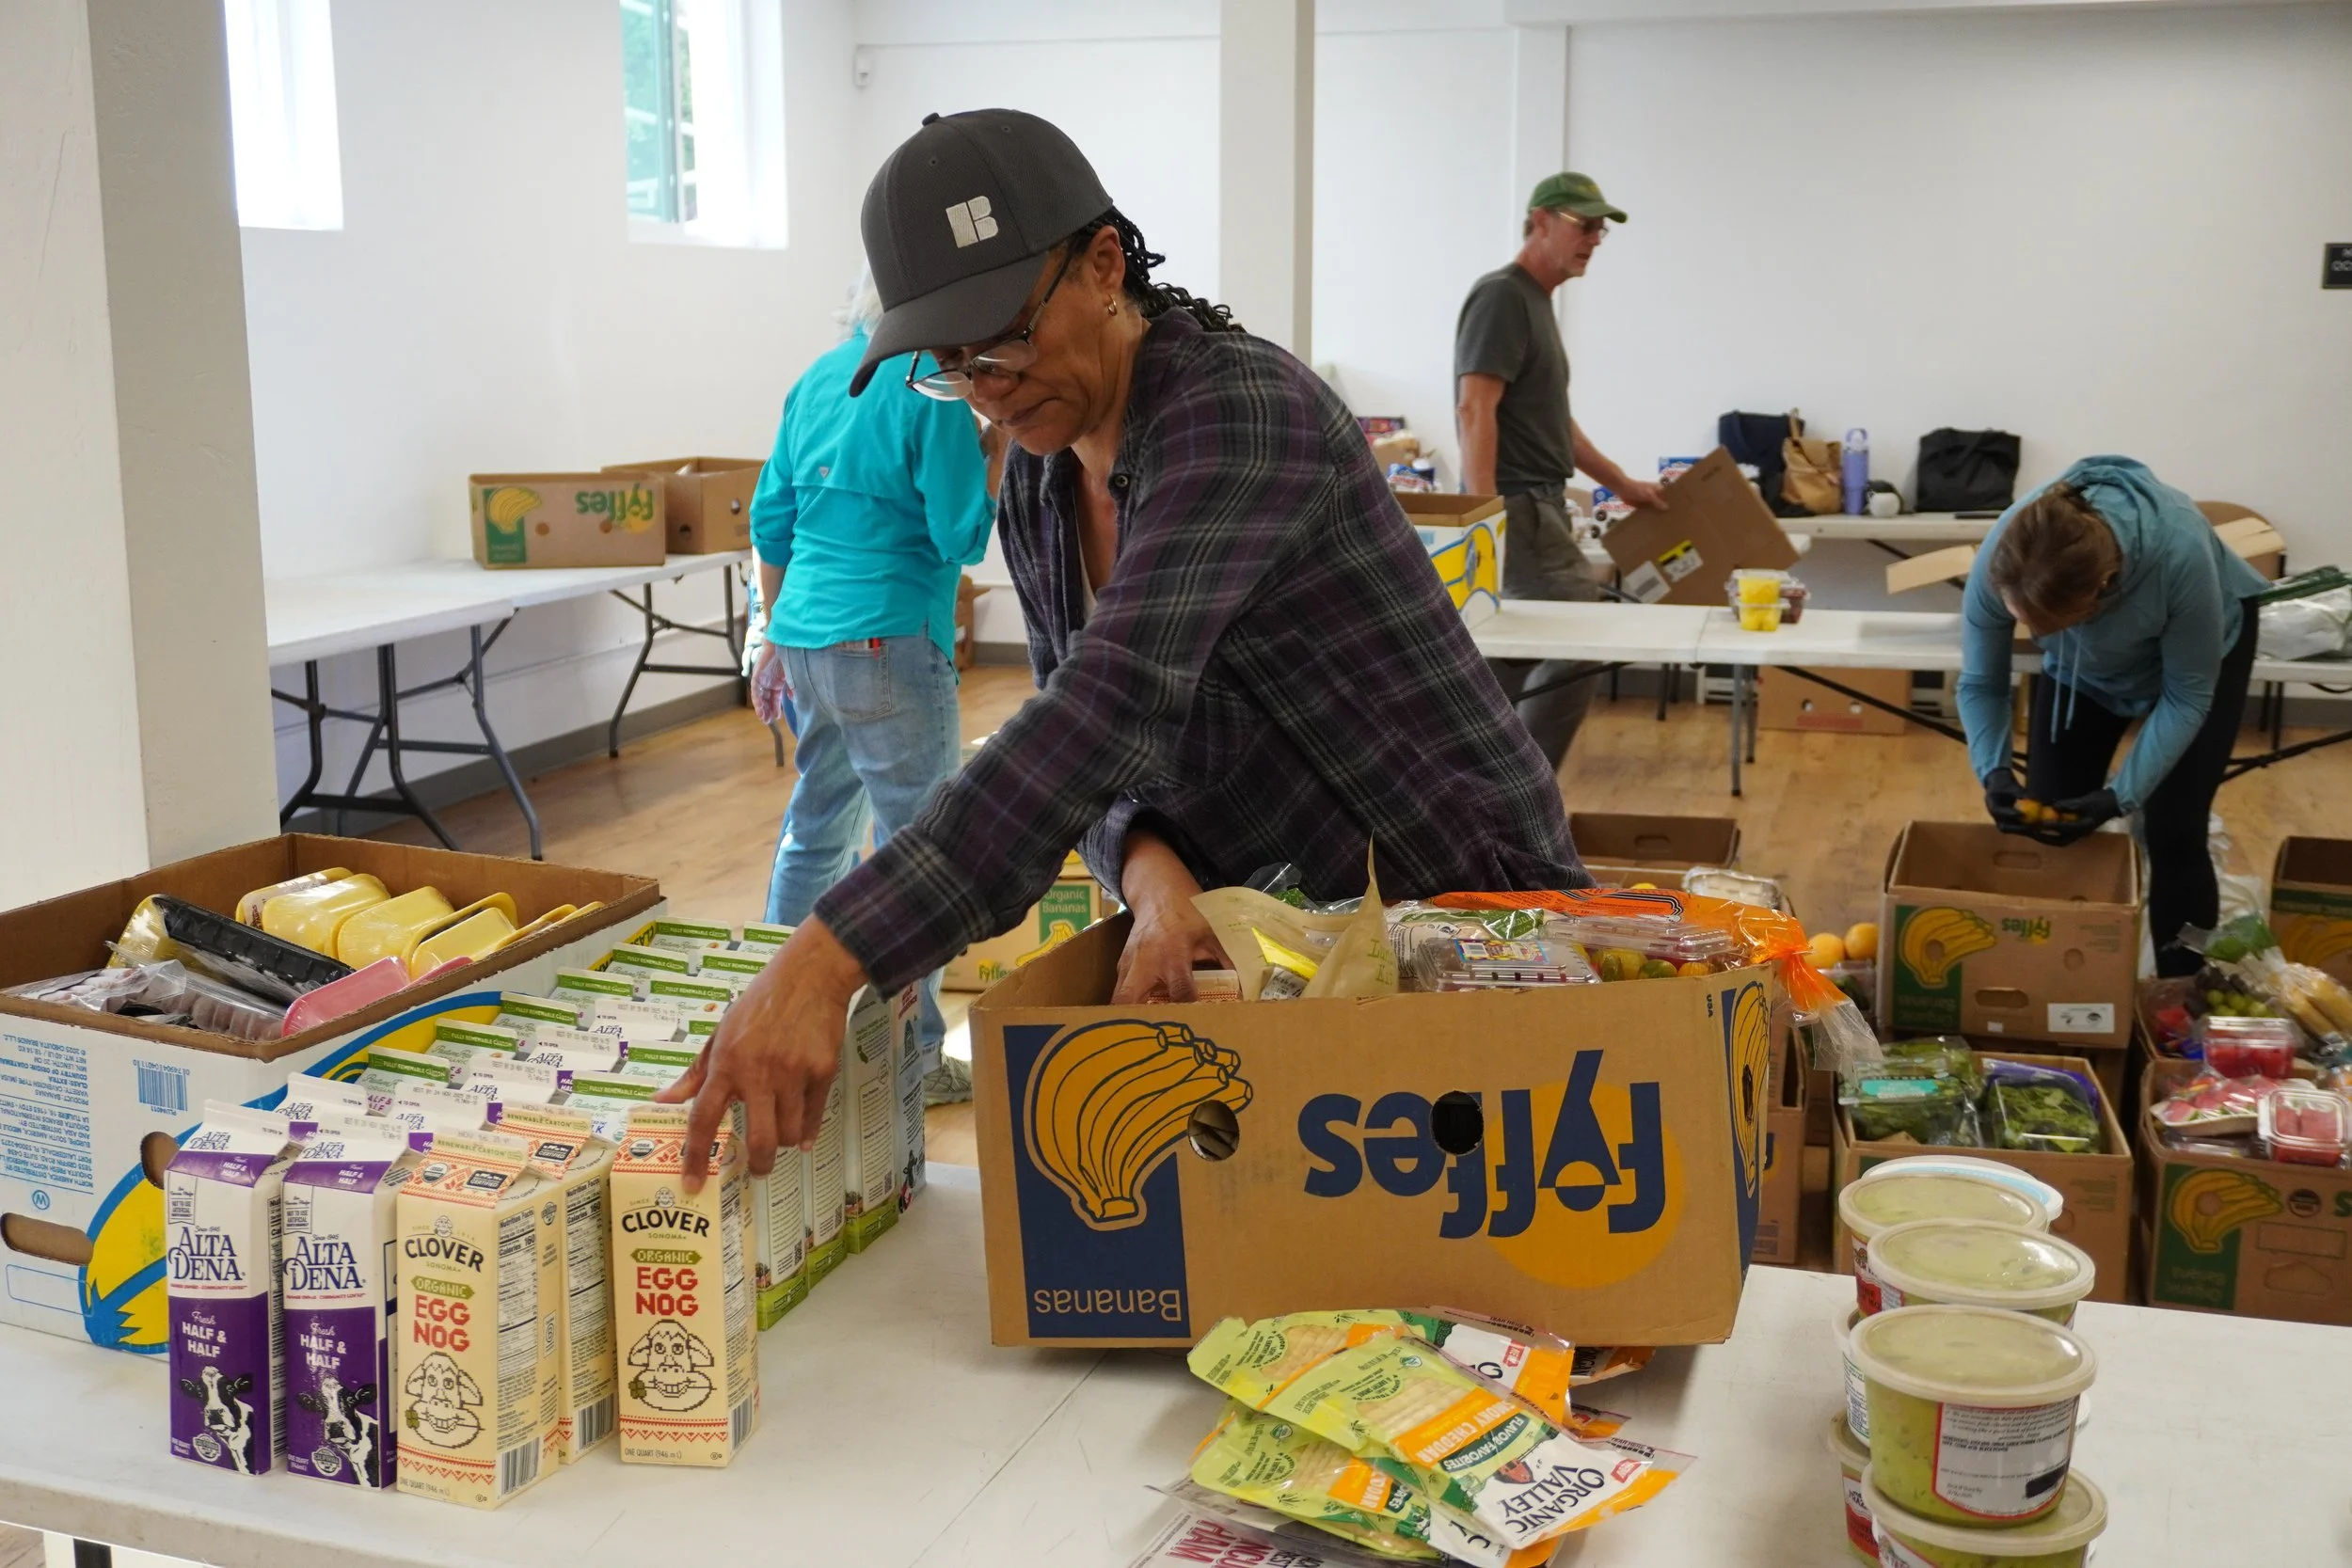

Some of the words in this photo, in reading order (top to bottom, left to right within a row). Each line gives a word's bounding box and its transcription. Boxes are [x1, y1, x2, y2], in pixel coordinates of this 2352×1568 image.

[286, 1102, 313, 1113] ALTA
[507, 1113, 543, 1124] RENEWABLE
[543, 1117, 571, 1128] CARTON
[190, 1138, 229, 1150] DENA
[201, 1132, 231, 1143] ALTA
[315, 1142, 345, 1152] ALTA
[437, 1139, 475, 1150] RENEWABLE
[475, 1145, 506, 1157] CARTON
[303, 1147, 344, 1159] DENA
[338, 1176, 358, 1185] HALF
[339, 1169, 357, 1178] HALF
[470, 1178, 499, 1188] CERTIFIED
[567, 1211, 588, 1224] Calories
[591, 1200, 601, 1212] 160
[622, 1210, 710, 1238] CLOVER
[179, 1227, 237, 1257] ALTA
[294, 1237, 357, 1266] ALTA
[499, 1243, 522, 1257] Calories
[524, 1235, 535, 1245] 160
[168, 1247, 243, 1281] DENA
[405, 1237, 484, 1273] CLOVER
[637, 1250, 693, 1264] ORGANIC
[283, 1258, 363, 1291] DENA
[426, 1261, 459, 1273] SONOMA
[416, 1277, 468, 1298] ORGANIC
[637, 1266, 698, 1291] EGG
[415, 1294, 470, 1326] EGG
[636, 1291, 699, 1317] NOG
[1035, 1288, 1181, 1322] Bananas
[191, 1310, 216, 1325] Fresh
[182, 1322, 214, 1339] HALF
[216, 1331, 227, 1344] &
[310, 1323, 335, 1337] Fresh
[414, 1320, 470, 1353] NOG
[188, 1339, 220, 1358] HALF
[300, 1334, 333, 1353] HALF
[337, 1340, 347, 1354] &
[306, 1353, 341, 1370] HALF
[1491, 1416, 1524, 1446] FLAVOR
[636, 1449, 653, 1458] QUART
[1415, 1423, 1477, 1464] CHEDDAR
[1443, 1438, 1496, 1471] FAVORITES
[400, 1477, 408, 1485] ONE
[409, 1479, 424, 1489] QUART
[1502, 1464, 1578, 1517] VALLEY
[1506, 1466, 1605, 1535] ORGANIC
[1165, 1518, 1238, 1563] HAM
